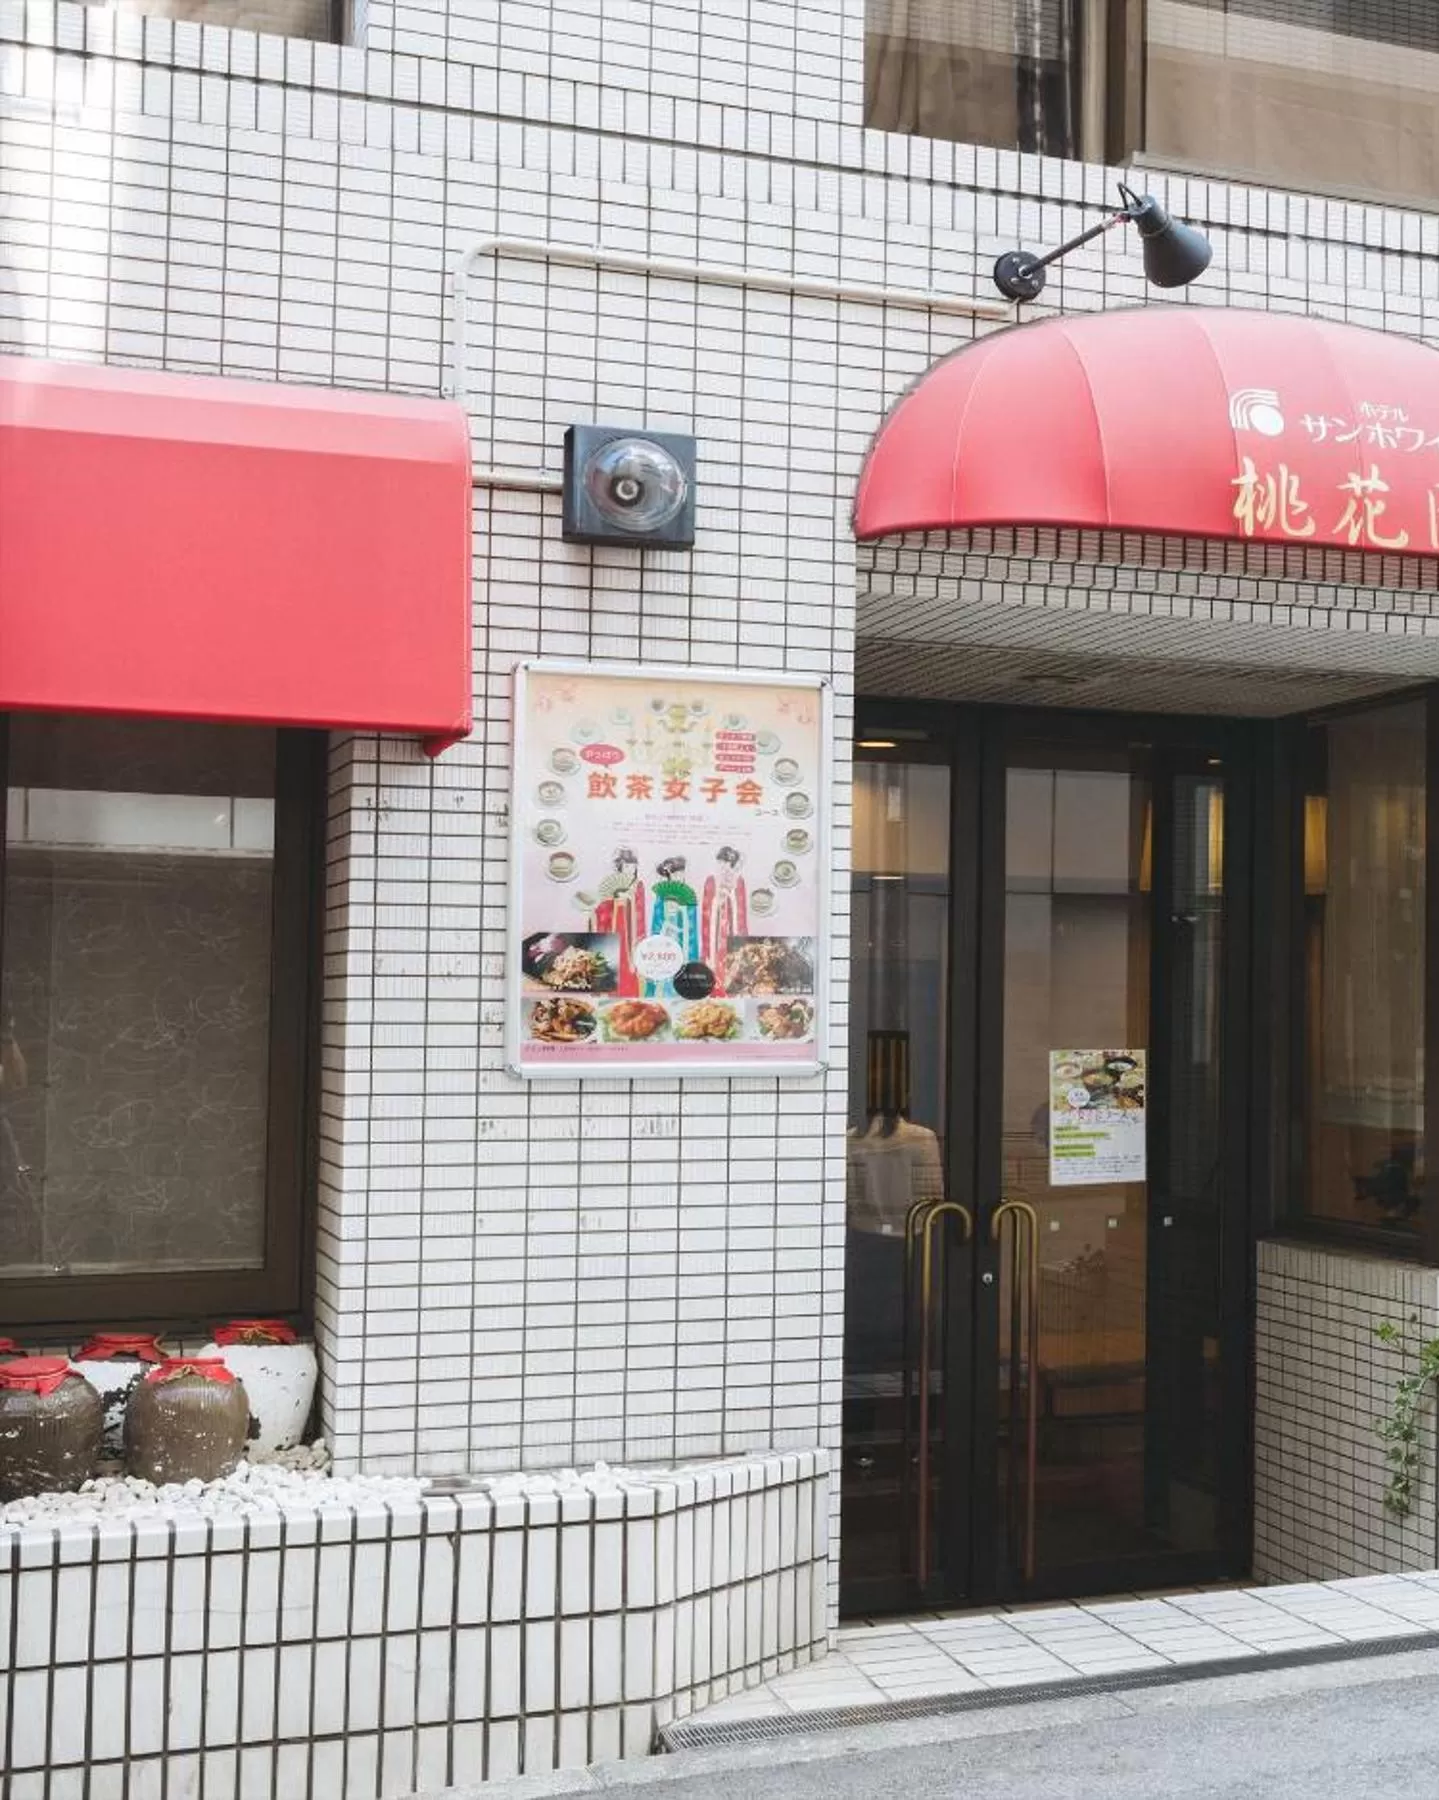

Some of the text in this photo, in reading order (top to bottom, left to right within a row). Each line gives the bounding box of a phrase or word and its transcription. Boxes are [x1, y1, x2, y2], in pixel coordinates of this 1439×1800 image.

[1360, 401, 1409, 422] ホテル
[587, 772, 763, 805] 飲茶女子会
